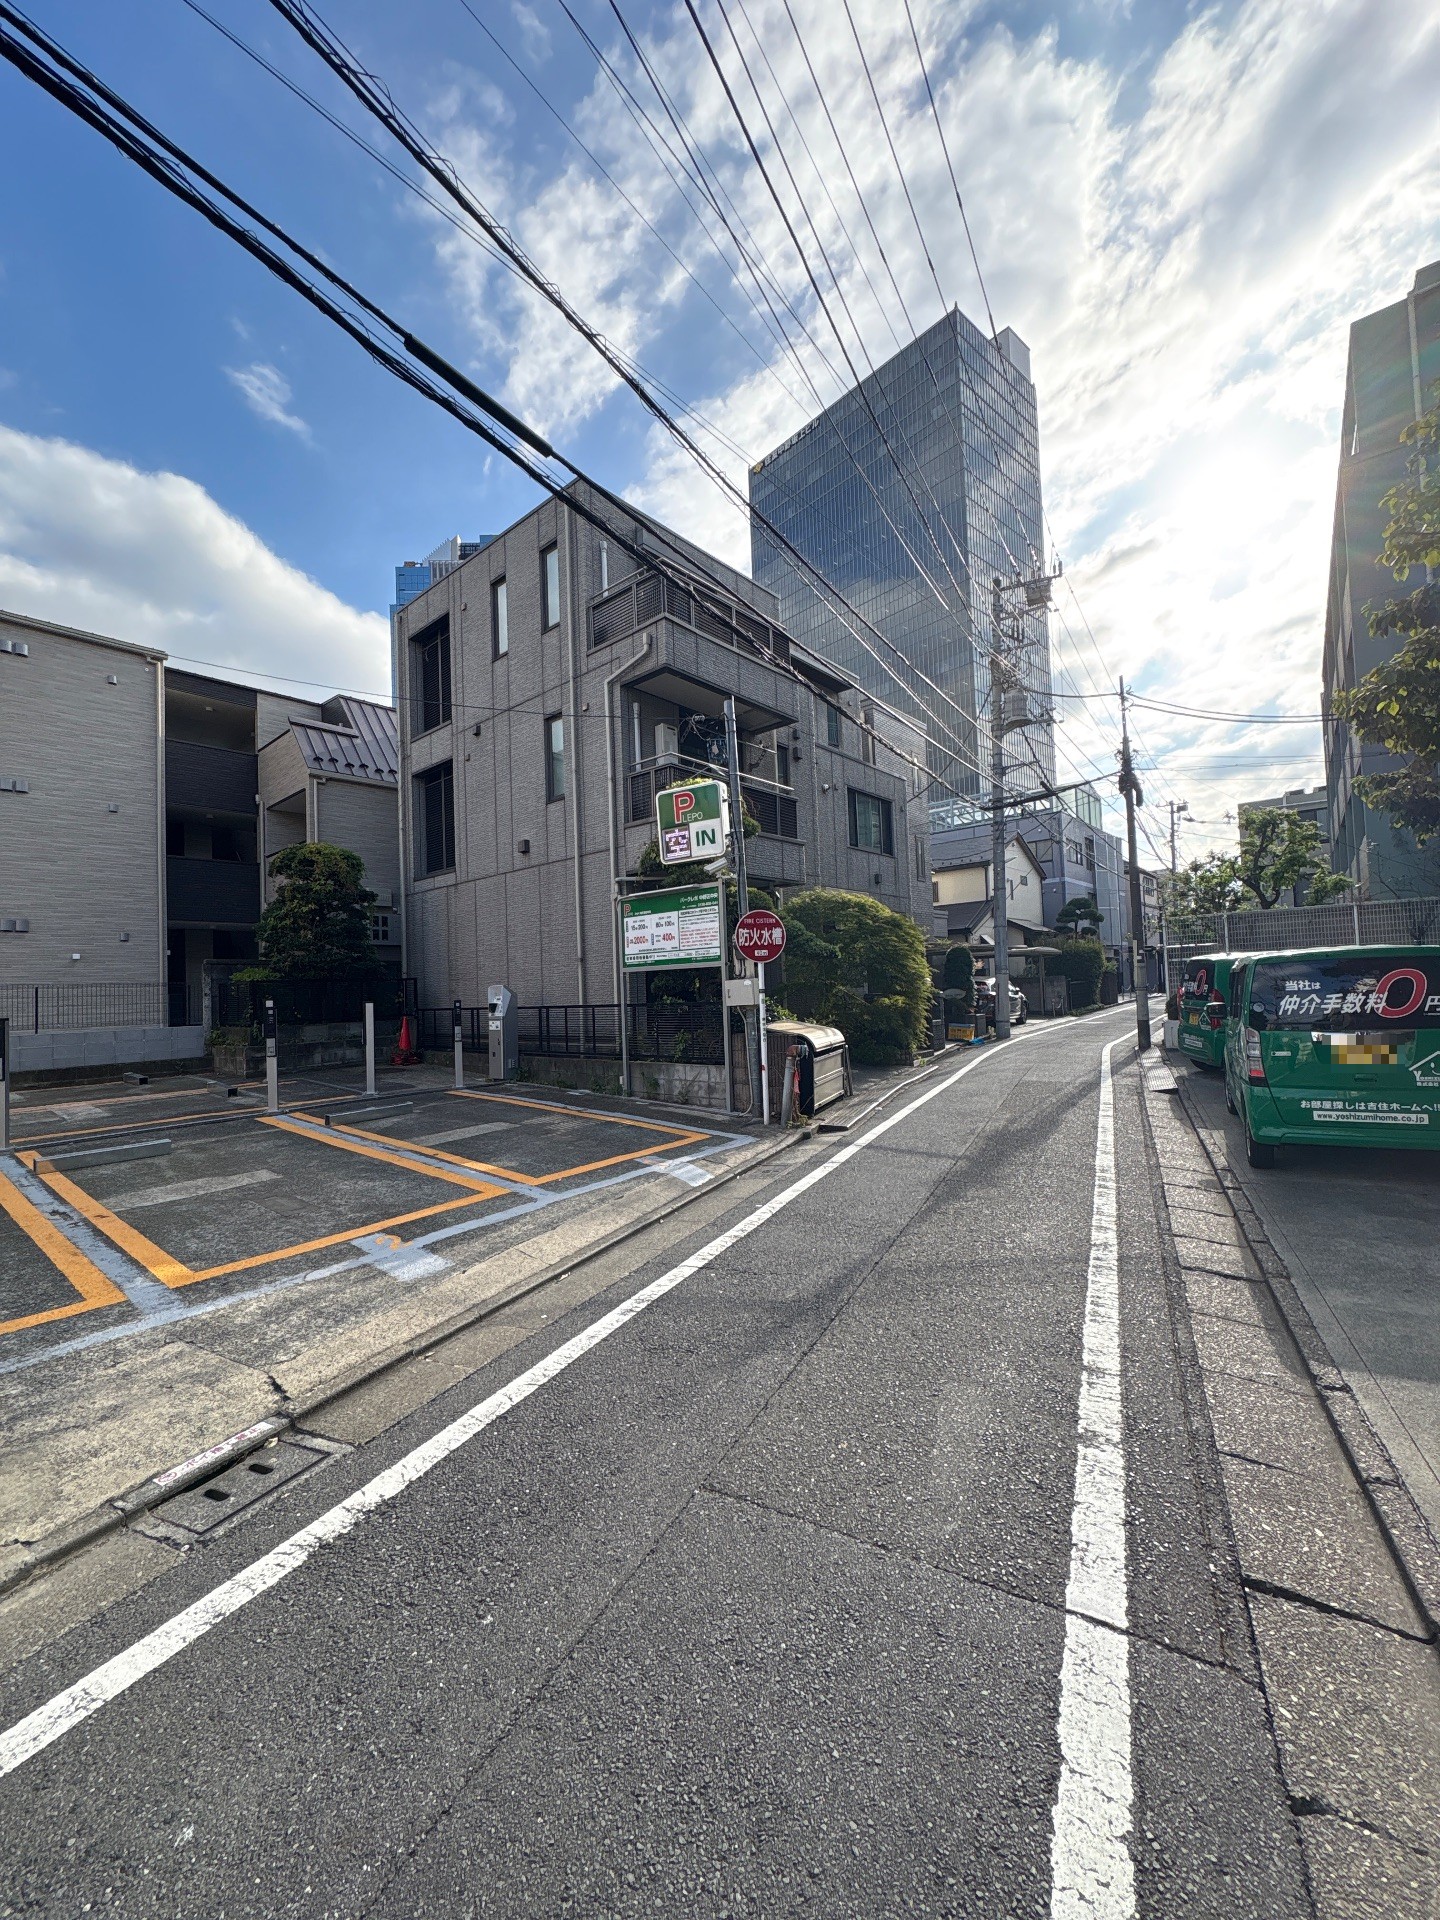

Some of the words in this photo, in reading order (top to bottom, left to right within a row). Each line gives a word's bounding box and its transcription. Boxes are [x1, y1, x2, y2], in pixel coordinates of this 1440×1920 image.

[672, 791, 695, 824] P
[682, 812, 703, 823] LEPO
[665, 828, 690, 858] 空
[695, 828, 716, 847] IN
[738, 926, 783, 946] 防火水槽
[1285, 979, 1321, 991] 当社は
[1317, 1112, 1425, 1123] www.yoshizumihome.co.jp
